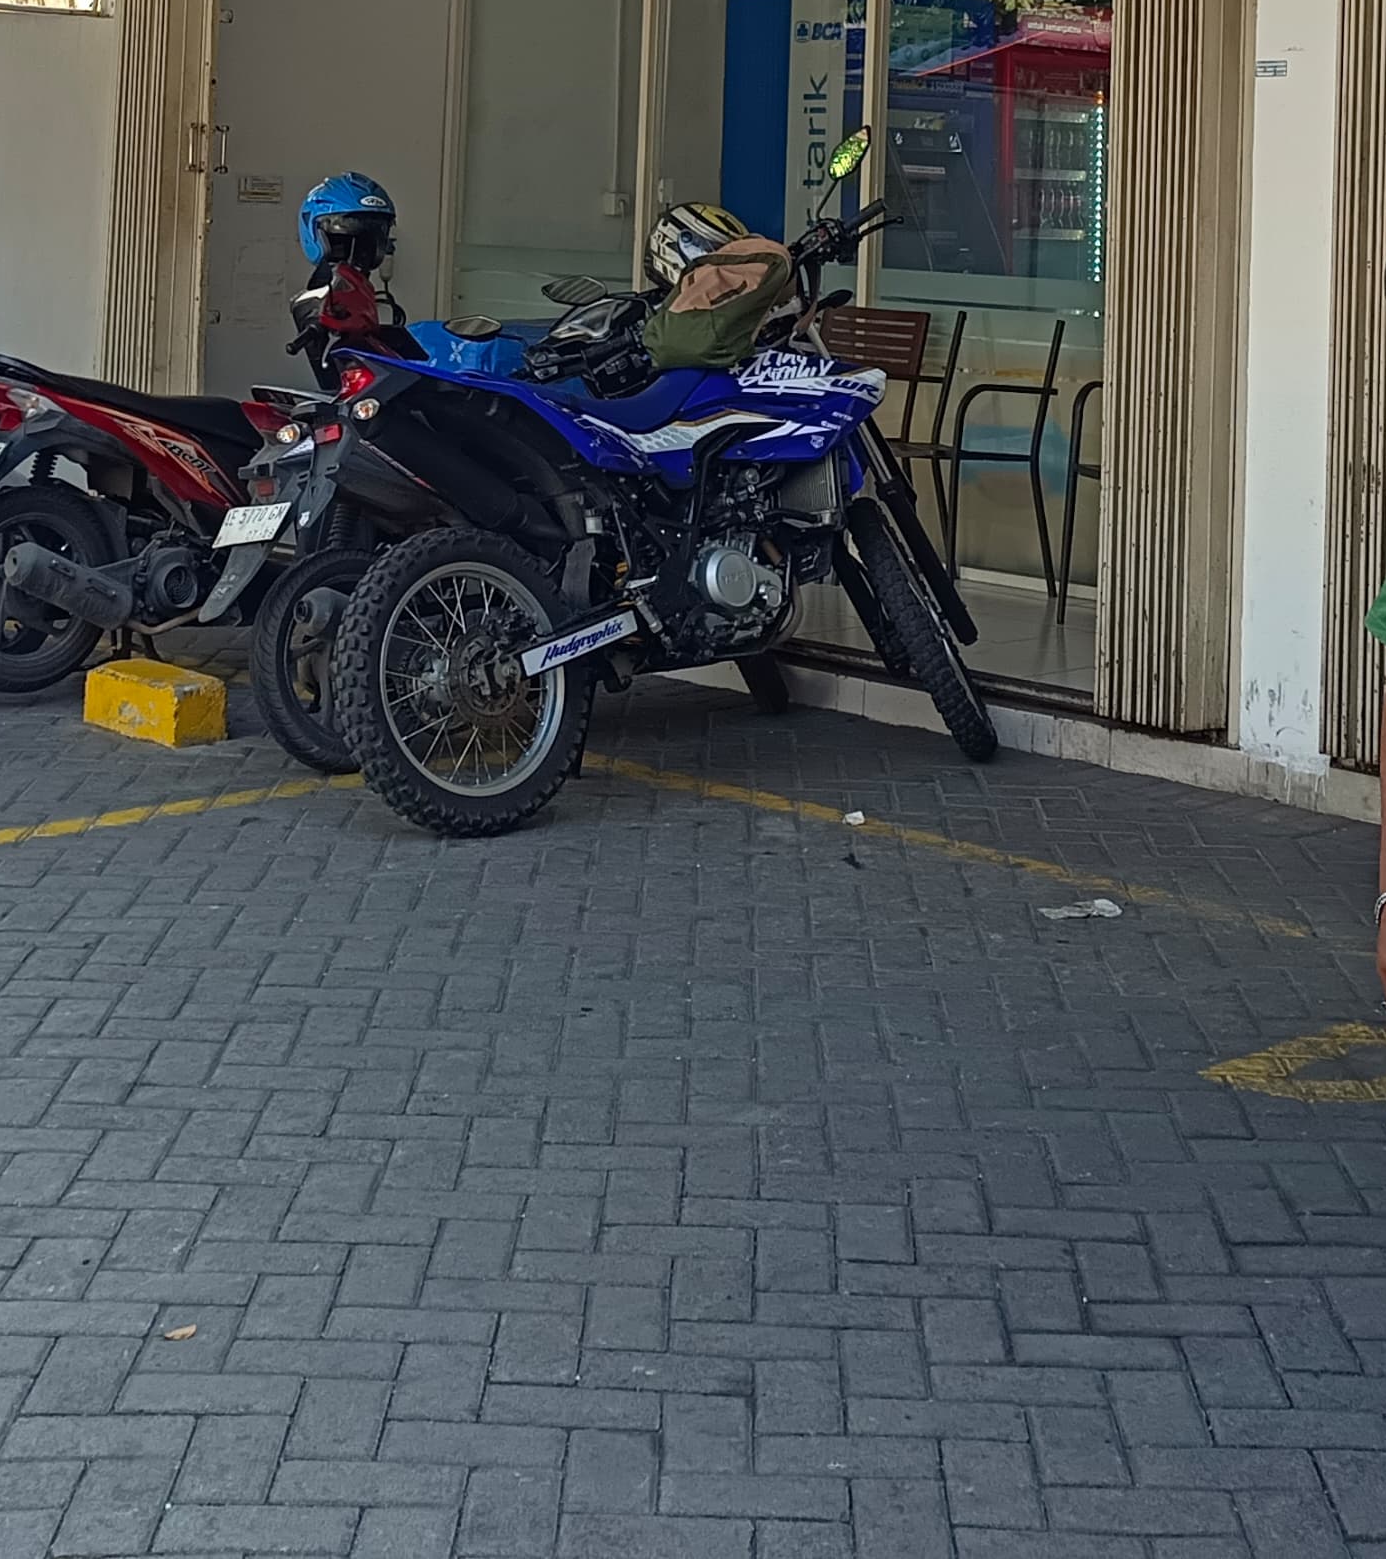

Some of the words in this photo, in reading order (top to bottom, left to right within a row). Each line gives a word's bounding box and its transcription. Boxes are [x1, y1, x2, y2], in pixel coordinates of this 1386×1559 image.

[811, 22, 842, 41] BCA
[803, 73, 828, 190] tarik
[830, 378, 880, 400] WR
